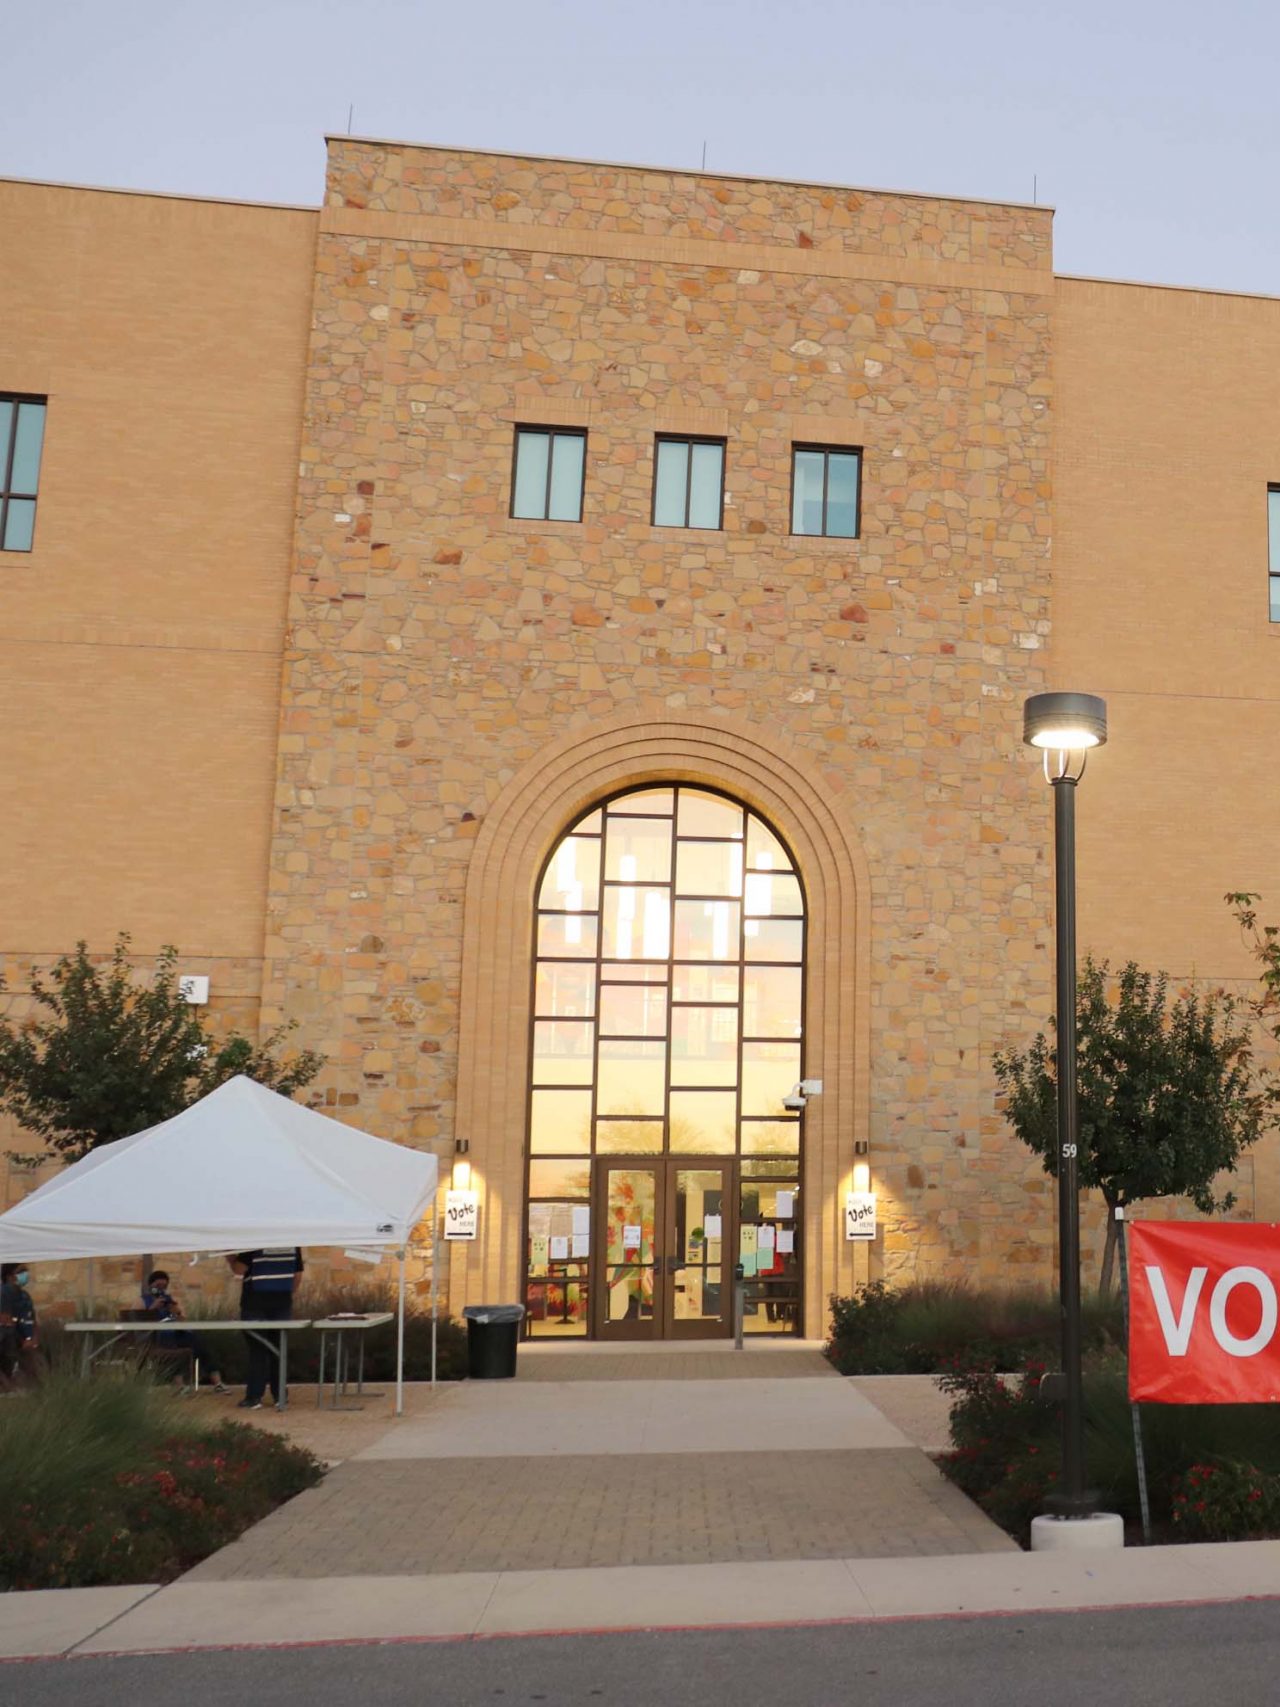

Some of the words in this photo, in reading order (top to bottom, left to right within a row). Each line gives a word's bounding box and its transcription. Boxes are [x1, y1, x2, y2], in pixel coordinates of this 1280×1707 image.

[1062, 1144, 1077, 1158] 59
[447, 1202, 475, 1221] Vote
[848, 1204, 873, 1222] Vote
